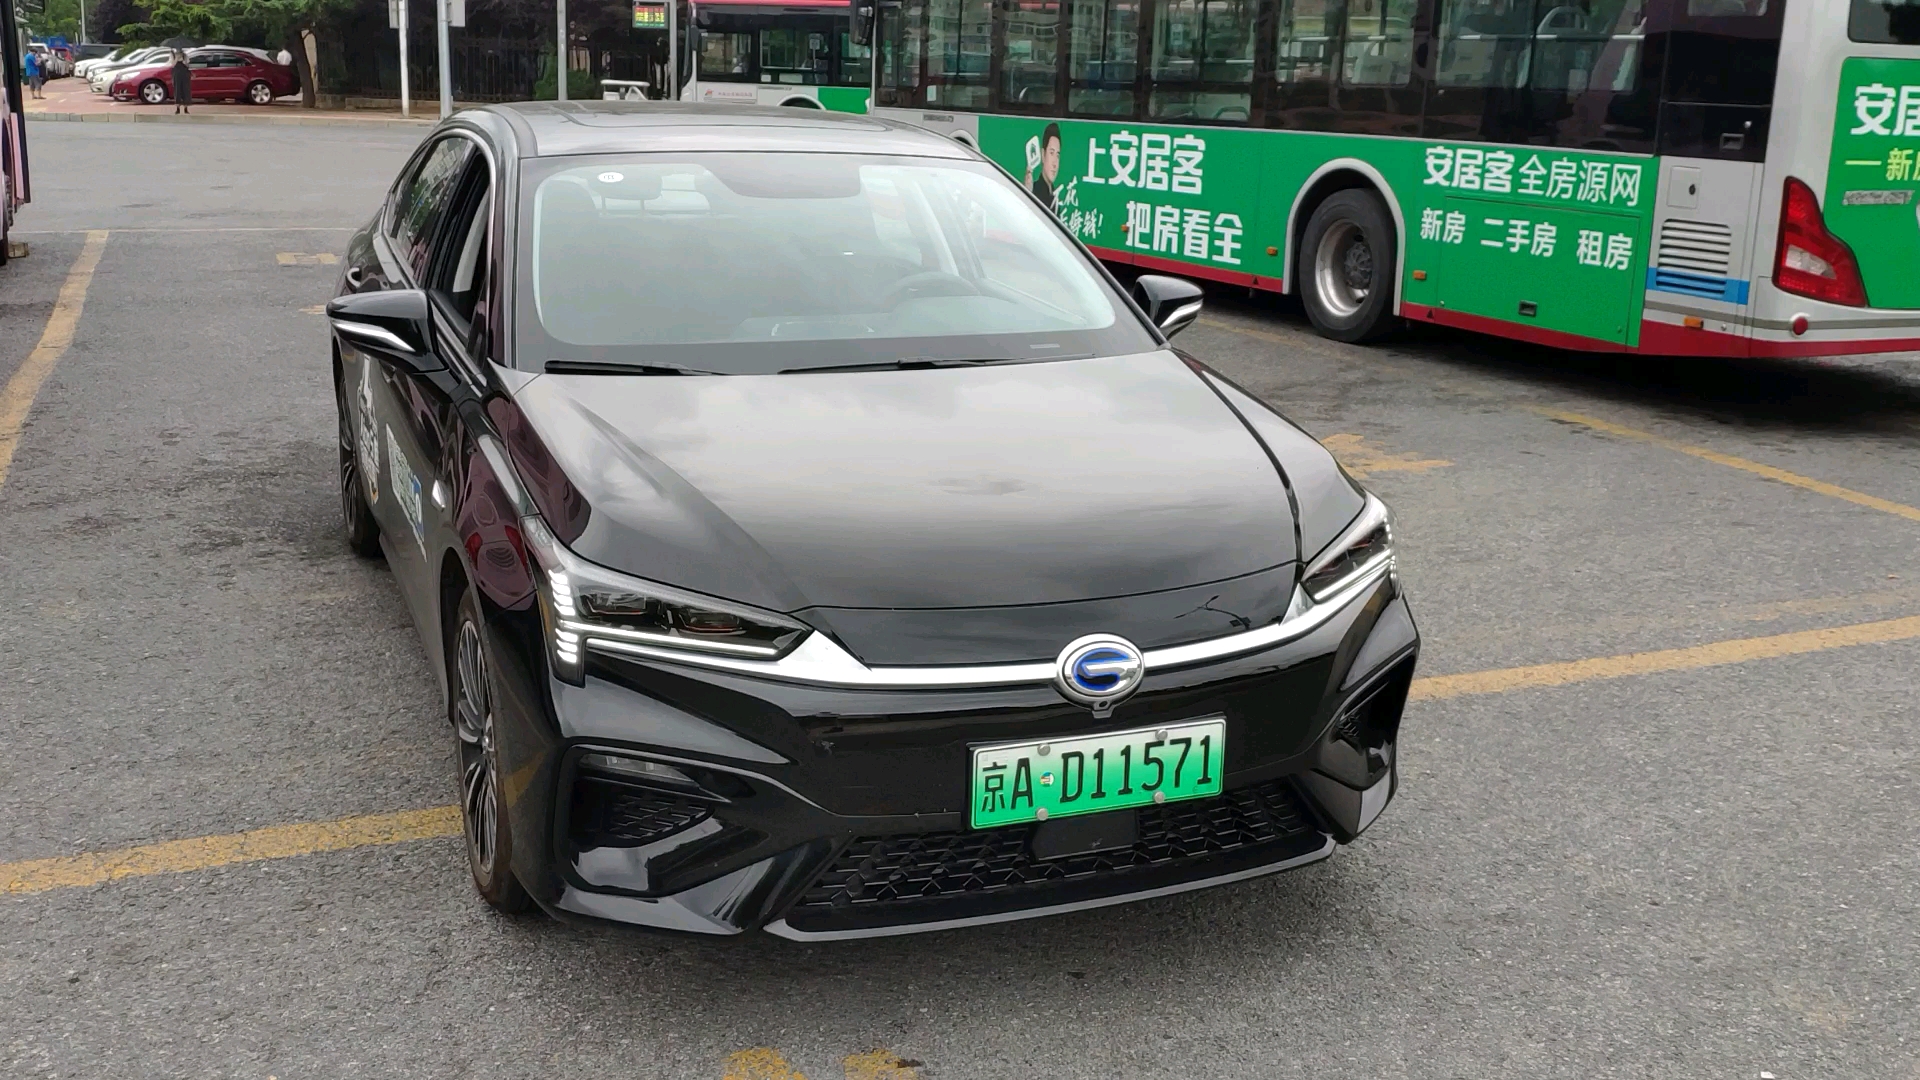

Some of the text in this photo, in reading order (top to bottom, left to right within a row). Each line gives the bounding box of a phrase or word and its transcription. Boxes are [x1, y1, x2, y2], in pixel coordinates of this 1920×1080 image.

[1082, 130, 1206, 195] 上安居客
[1125, 200, 1243, 265] 把房看全
[1420, 207, 1633, 271] 新房 二手房 租房
